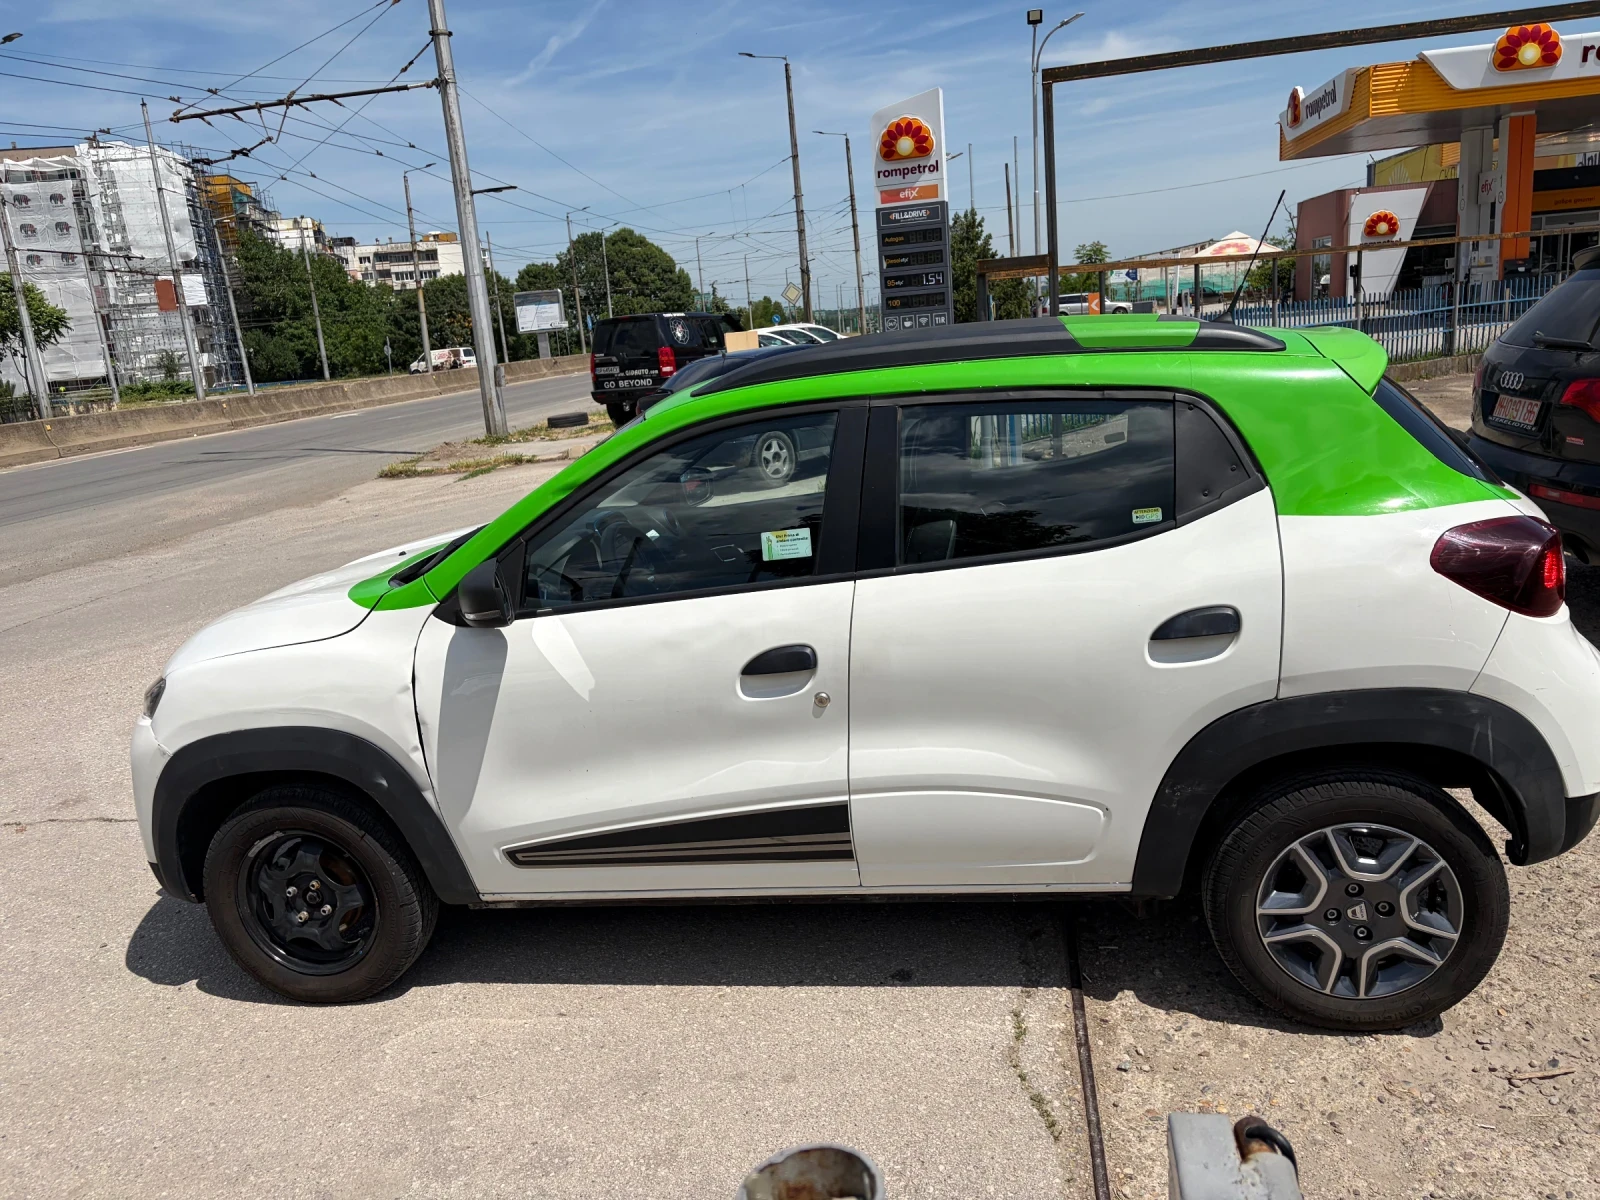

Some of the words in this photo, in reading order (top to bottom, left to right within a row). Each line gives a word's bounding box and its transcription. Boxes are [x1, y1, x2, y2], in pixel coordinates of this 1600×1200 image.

[1305, 79, 1337, 119] rompetrol
[877, 160, 939, 179] rompetrol
[900, 188, 919, 199] efix
[922, 272, 943, 285] 1.54
[603, 381, 616, 389] GO
[618, 378, 653, 388] BEYOND
